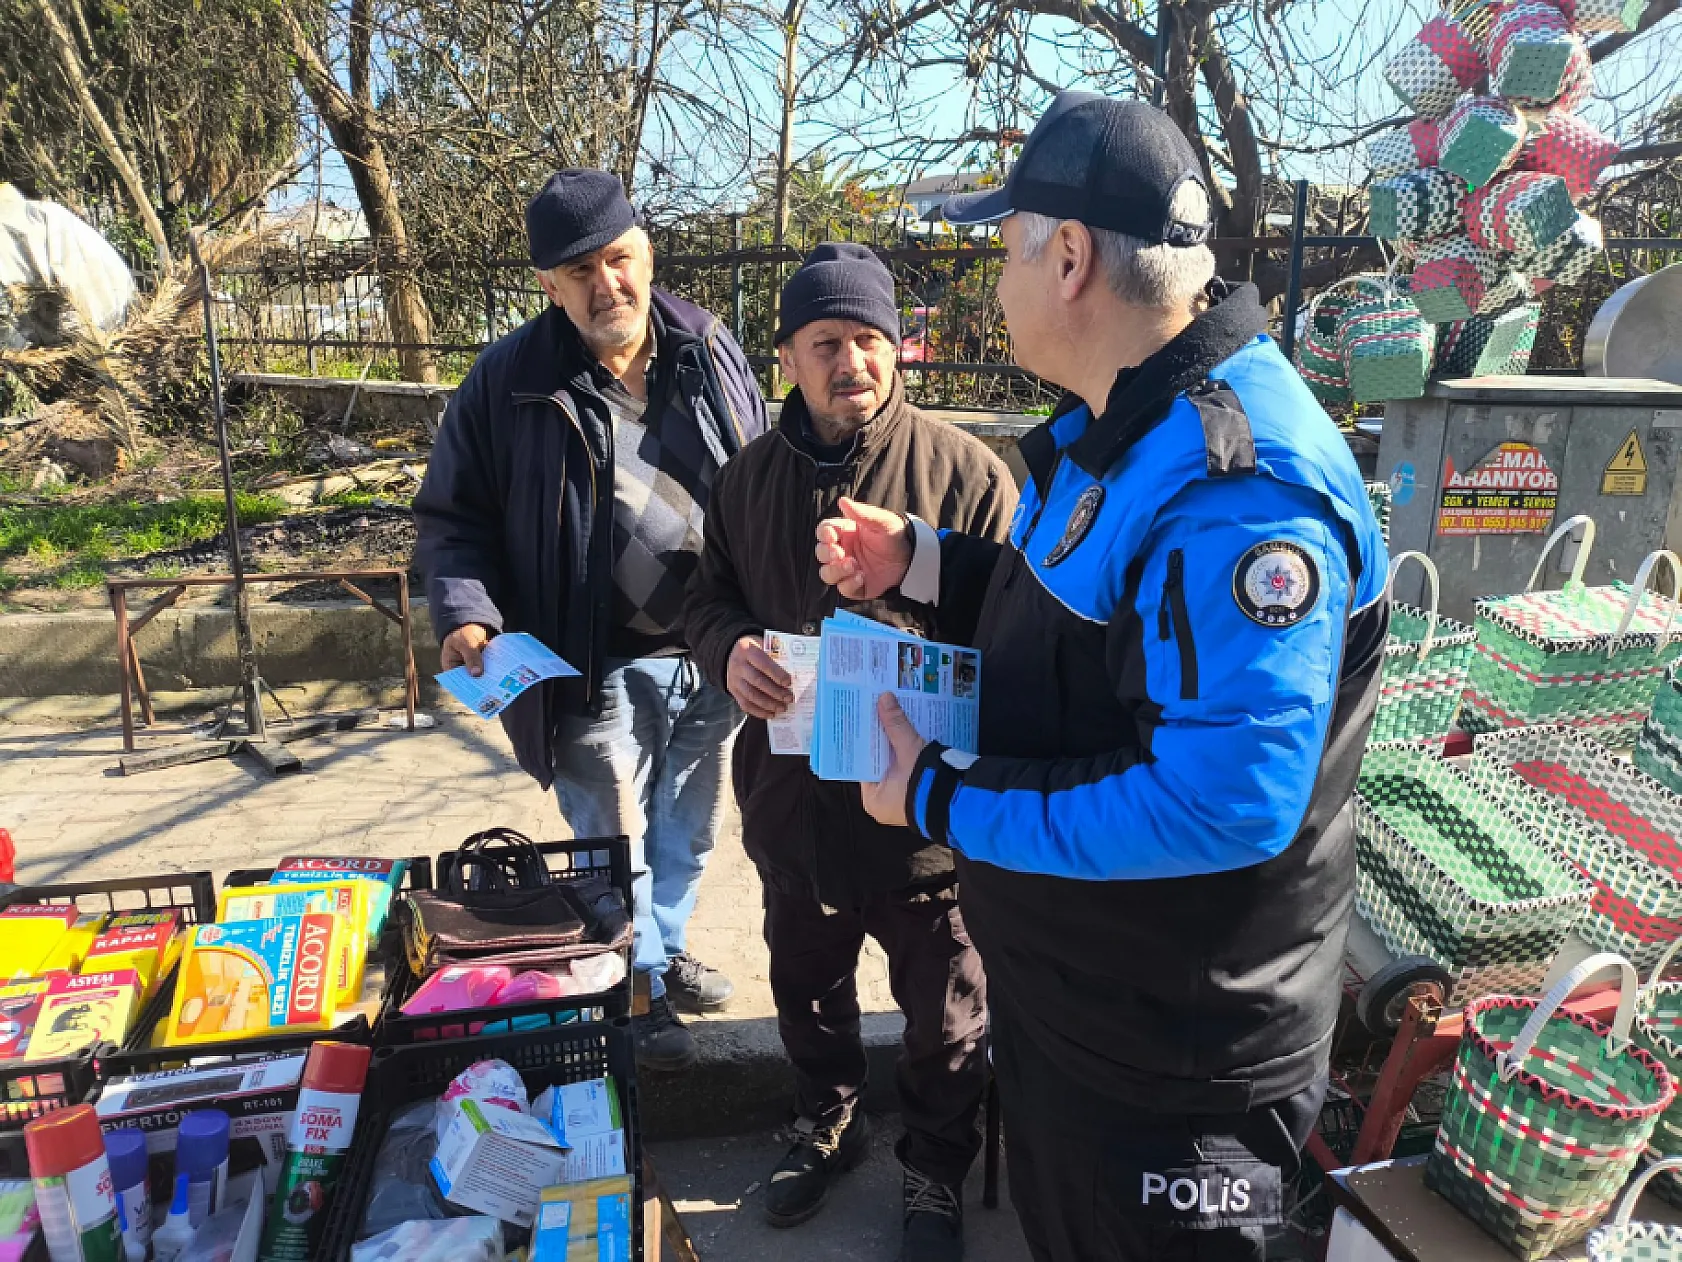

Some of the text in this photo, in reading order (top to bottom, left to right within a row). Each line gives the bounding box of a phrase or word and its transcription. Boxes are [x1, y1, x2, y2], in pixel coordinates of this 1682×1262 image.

[286, 858, 382, 869] ACORD
[294, 923, 328, 1012] ACORD
[242, 1097, 283, 1110] RT-101
[304, 1127, 331, 1141] FIX
